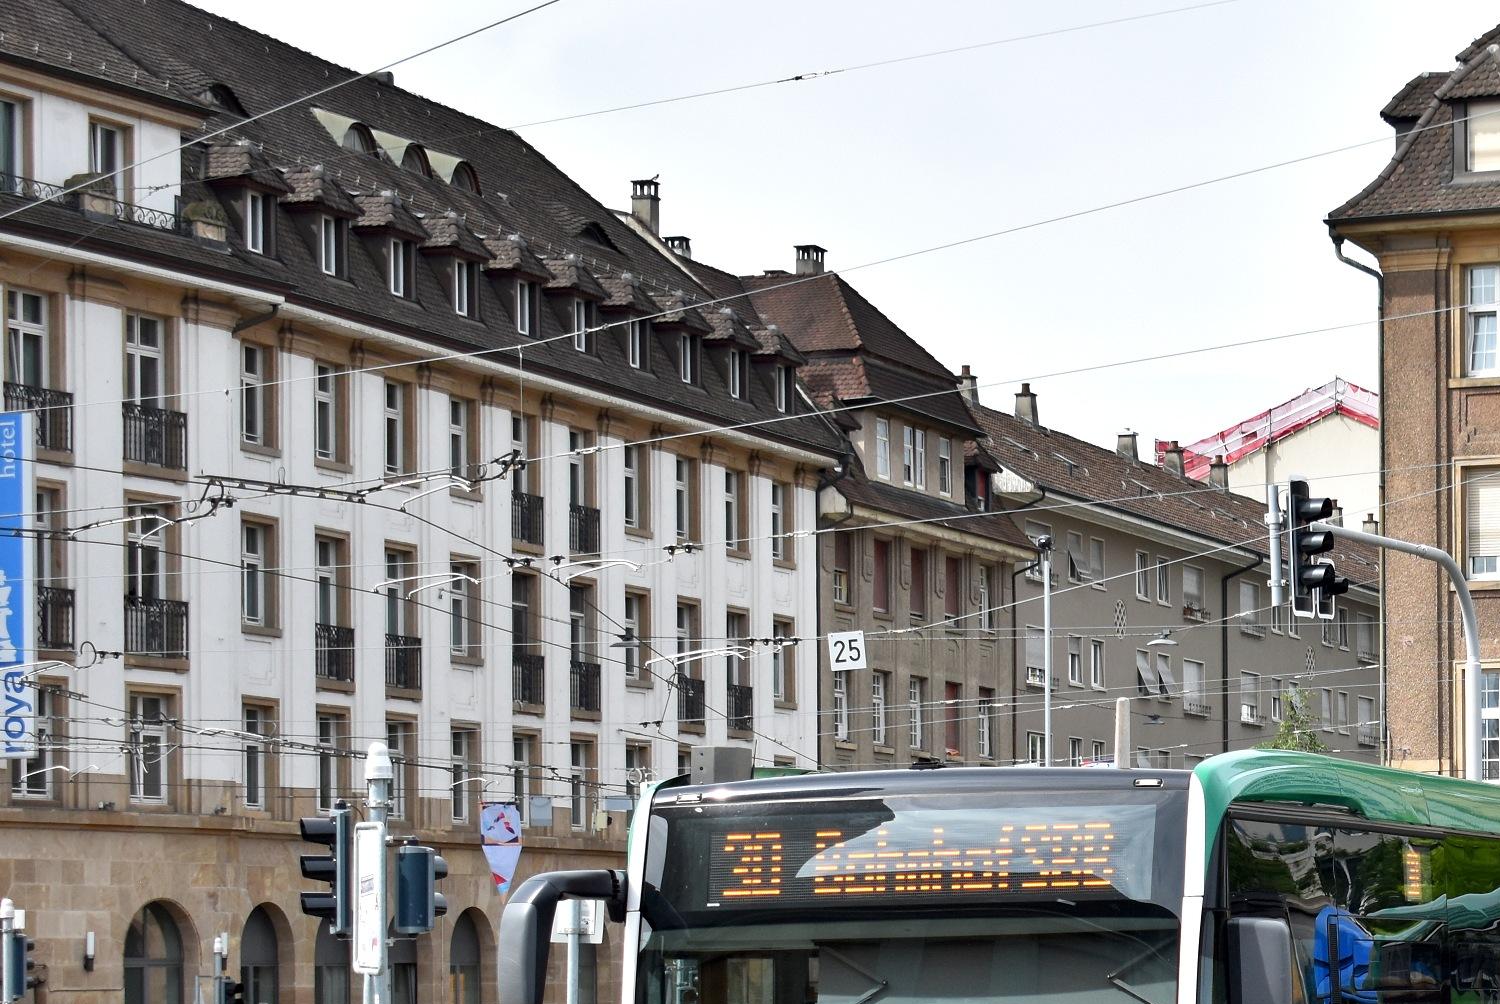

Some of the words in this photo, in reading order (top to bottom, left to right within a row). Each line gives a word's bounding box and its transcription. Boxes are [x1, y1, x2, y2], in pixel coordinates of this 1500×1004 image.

[0, 421, 16, 478] hotel
[833, 638, 861, 664] 25
[0, 661, 32, 752] royal
[723, 833, 782, 895] 30
[814, 825, 1014, 893] Bahnhof
[1020, 823, 1115, 889] SBB
